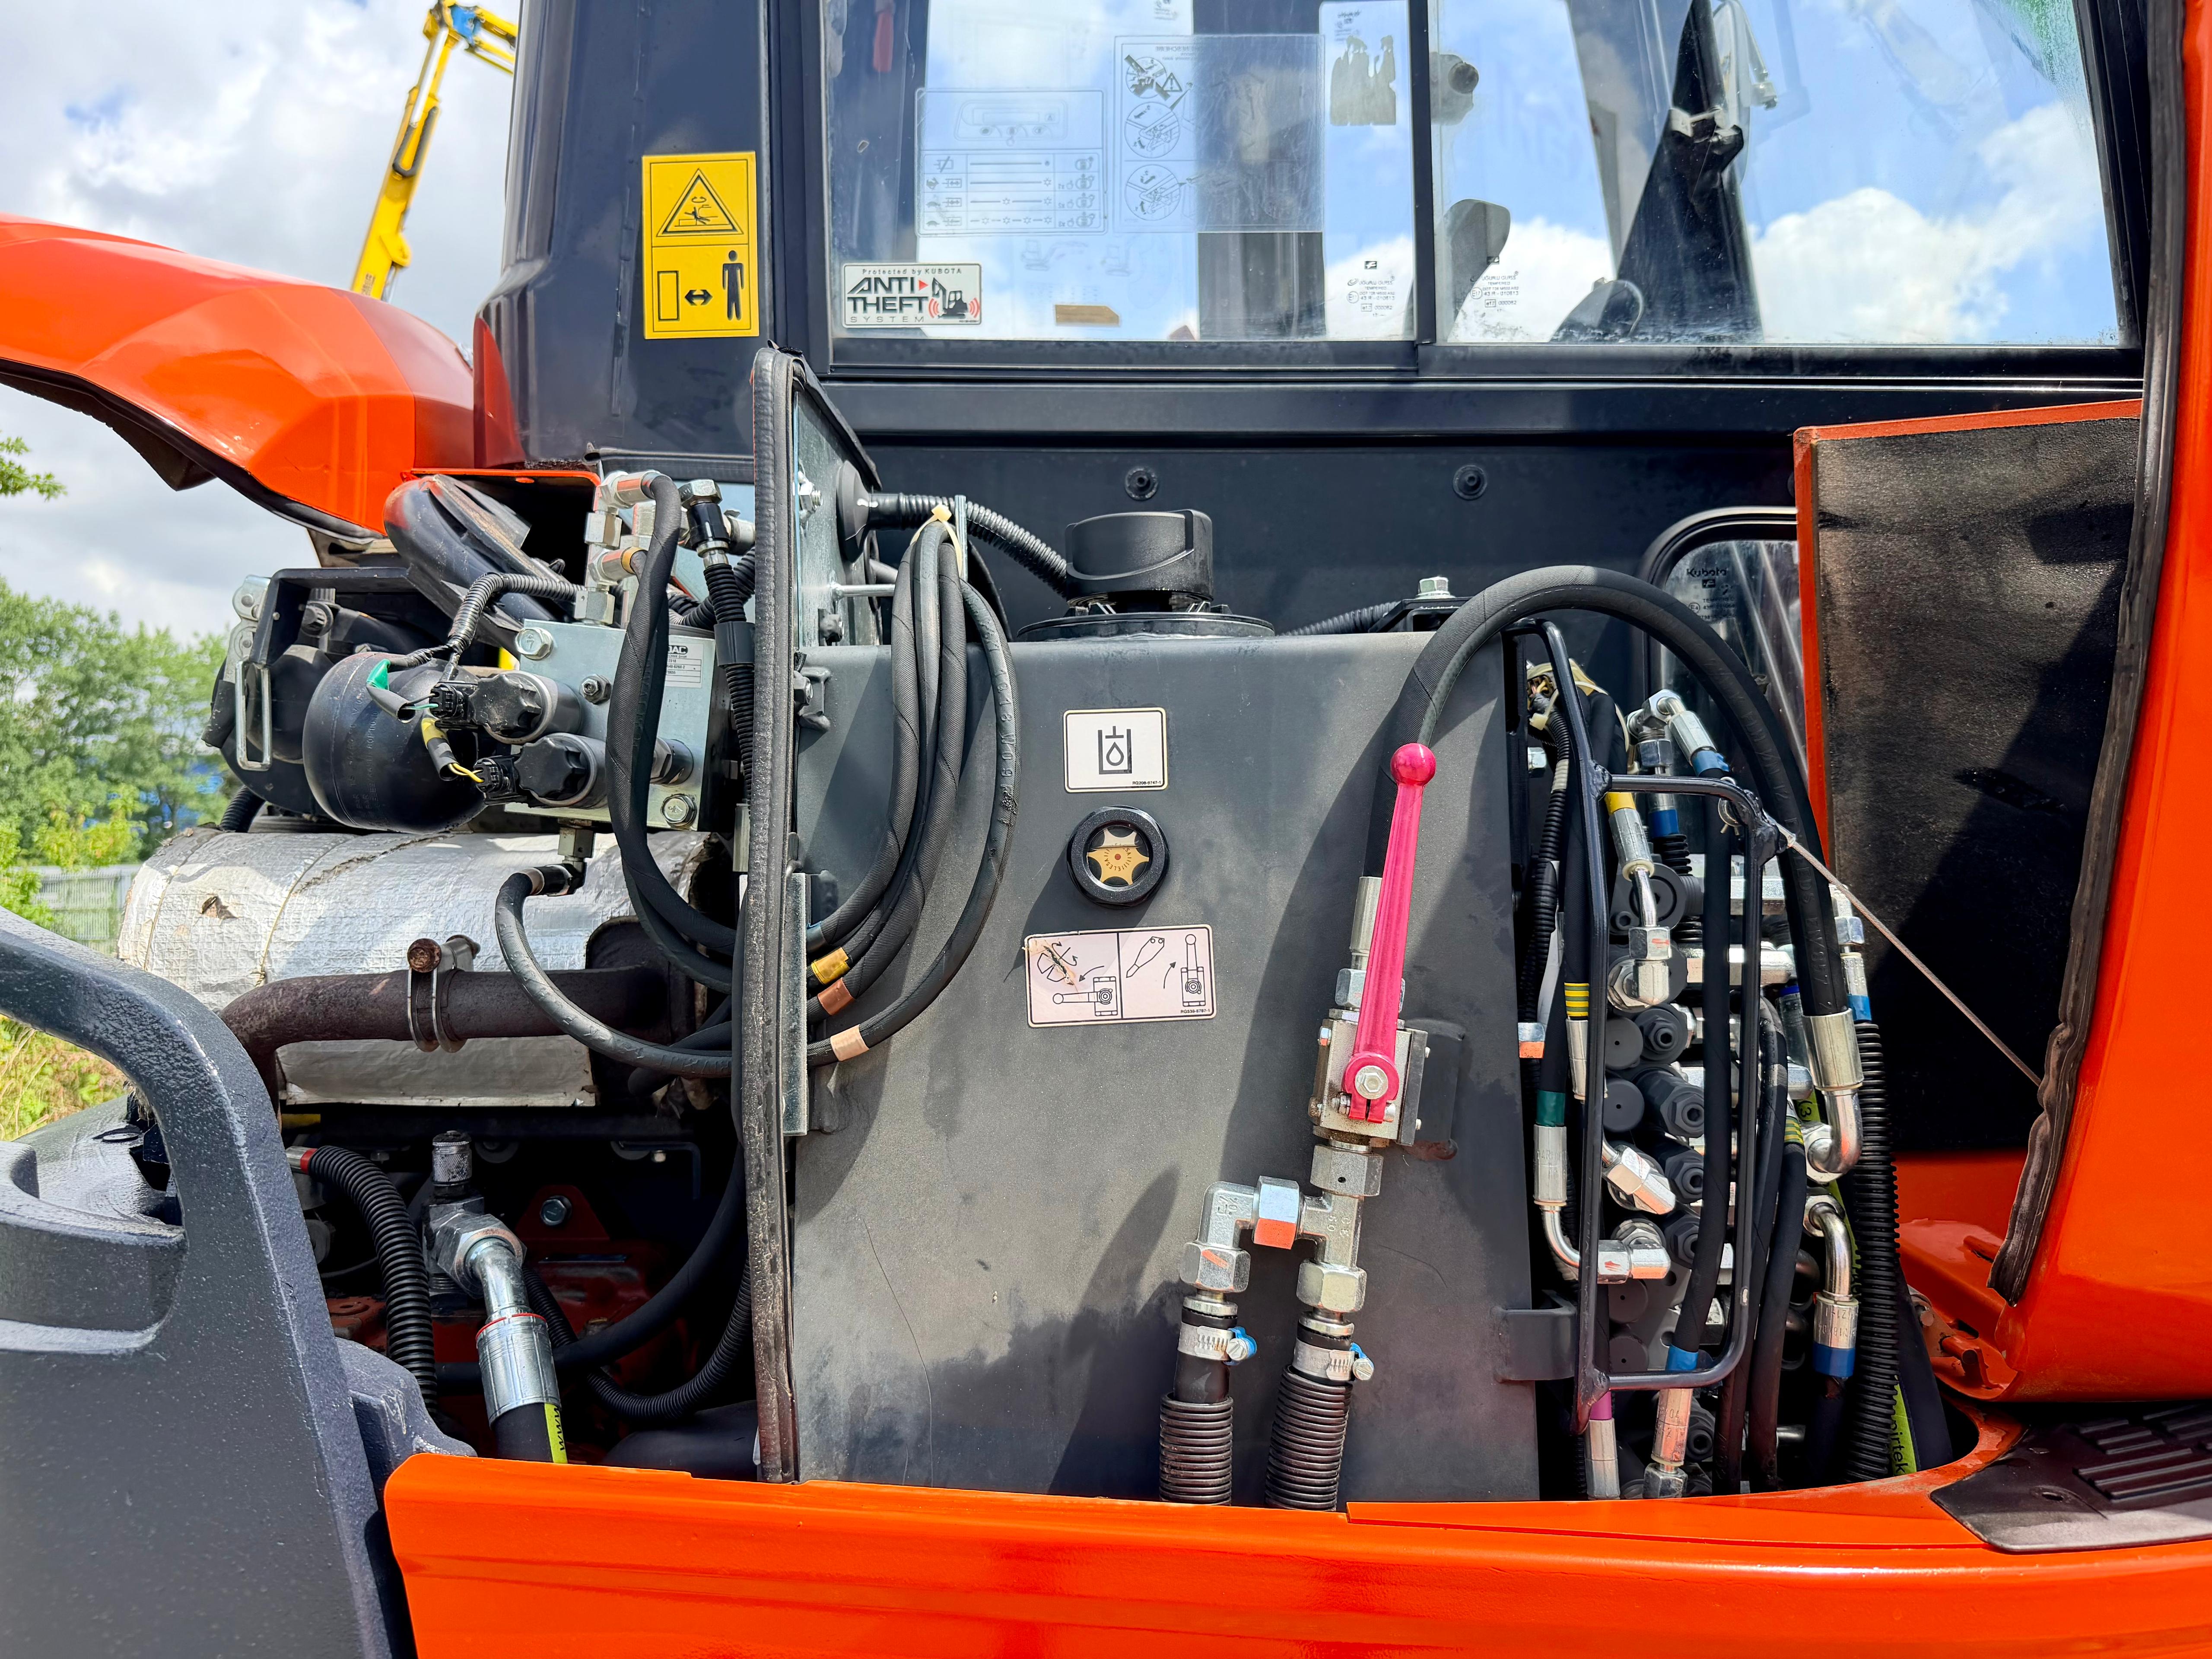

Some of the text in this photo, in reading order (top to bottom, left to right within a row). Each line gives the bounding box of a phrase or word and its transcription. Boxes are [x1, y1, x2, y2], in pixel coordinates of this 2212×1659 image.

[847, 277, 915, 294] ANTI
[847, 296, 928, 314] THEFT
[1687, 567, 1727, 578] Kubota
